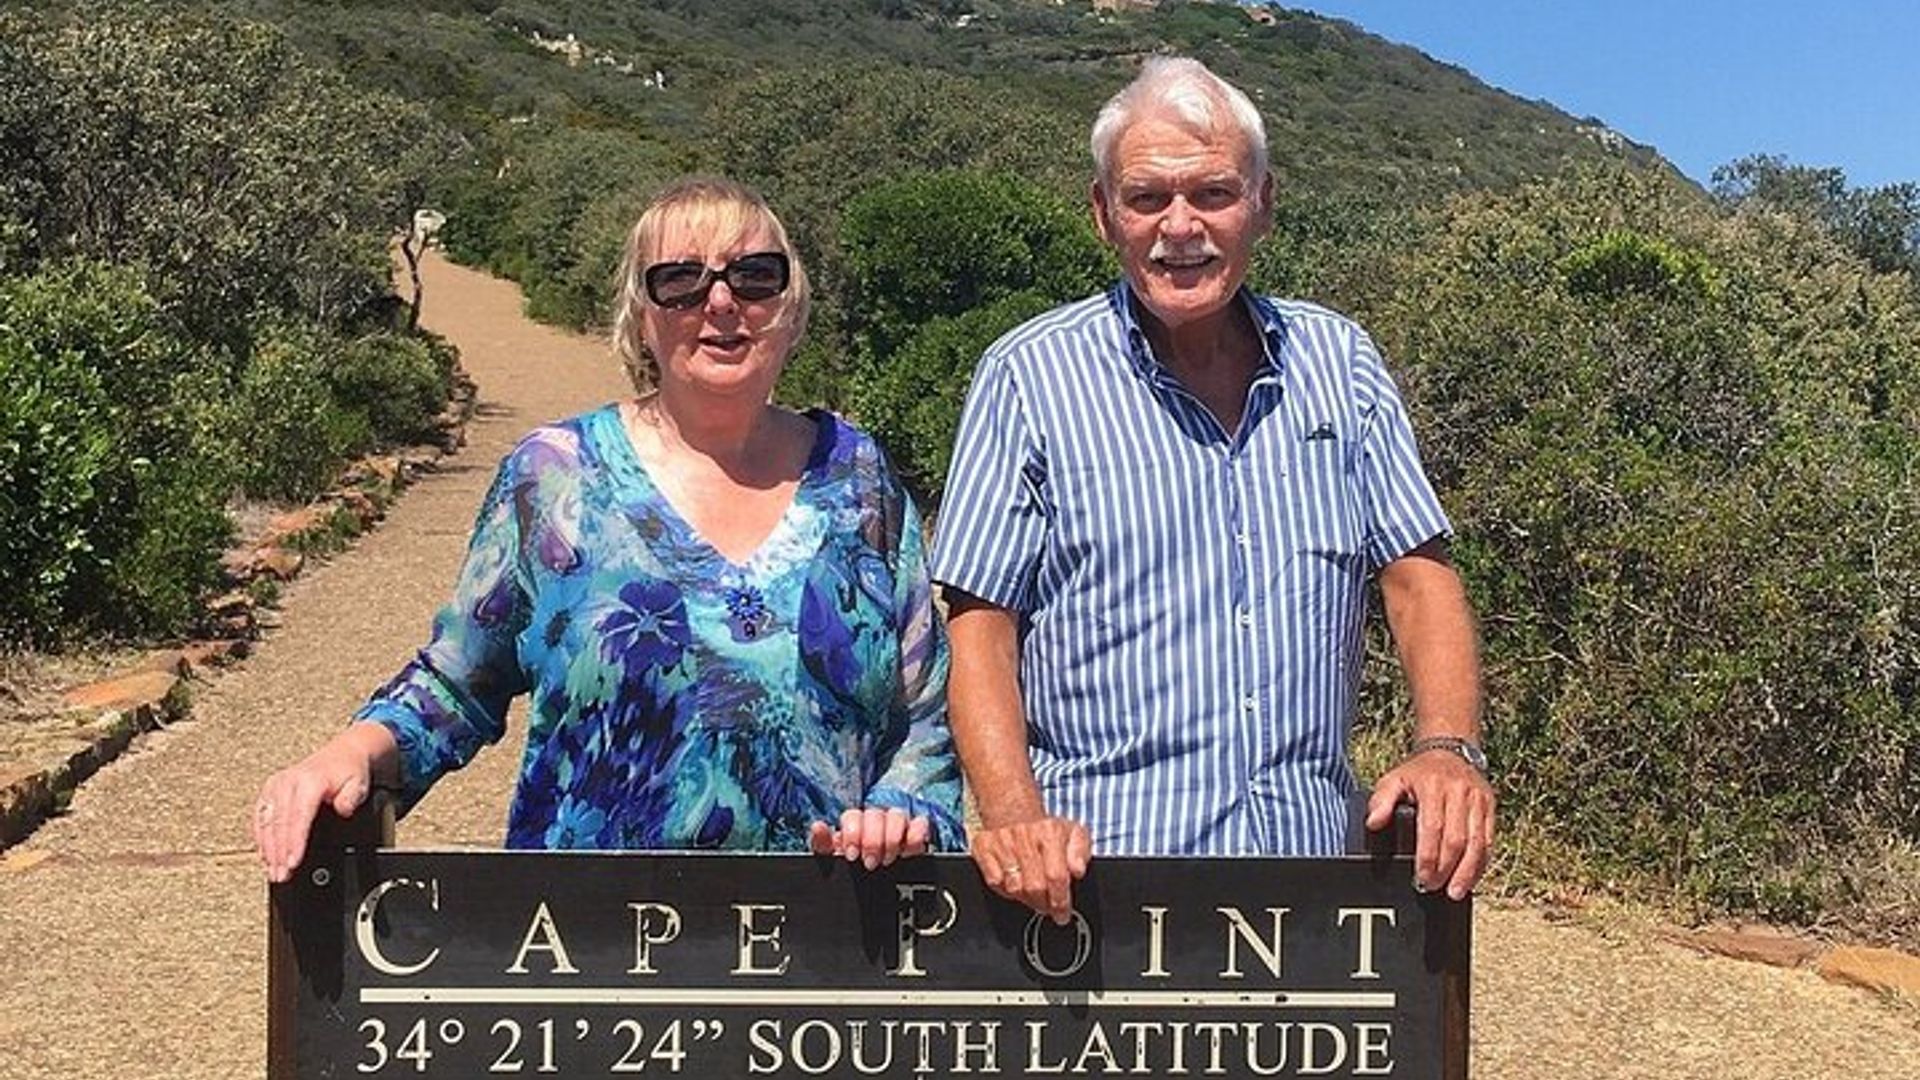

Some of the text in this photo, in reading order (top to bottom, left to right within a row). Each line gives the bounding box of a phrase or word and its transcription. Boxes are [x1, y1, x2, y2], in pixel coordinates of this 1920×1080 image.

[355, 877, 1397, 979] CAPE POINT
[355, 1018, 465, 1073] 34°
[747, 1019, 1002, 1074] SOUTH
[1023, 1020, 1396, 1075] LATITUDE
